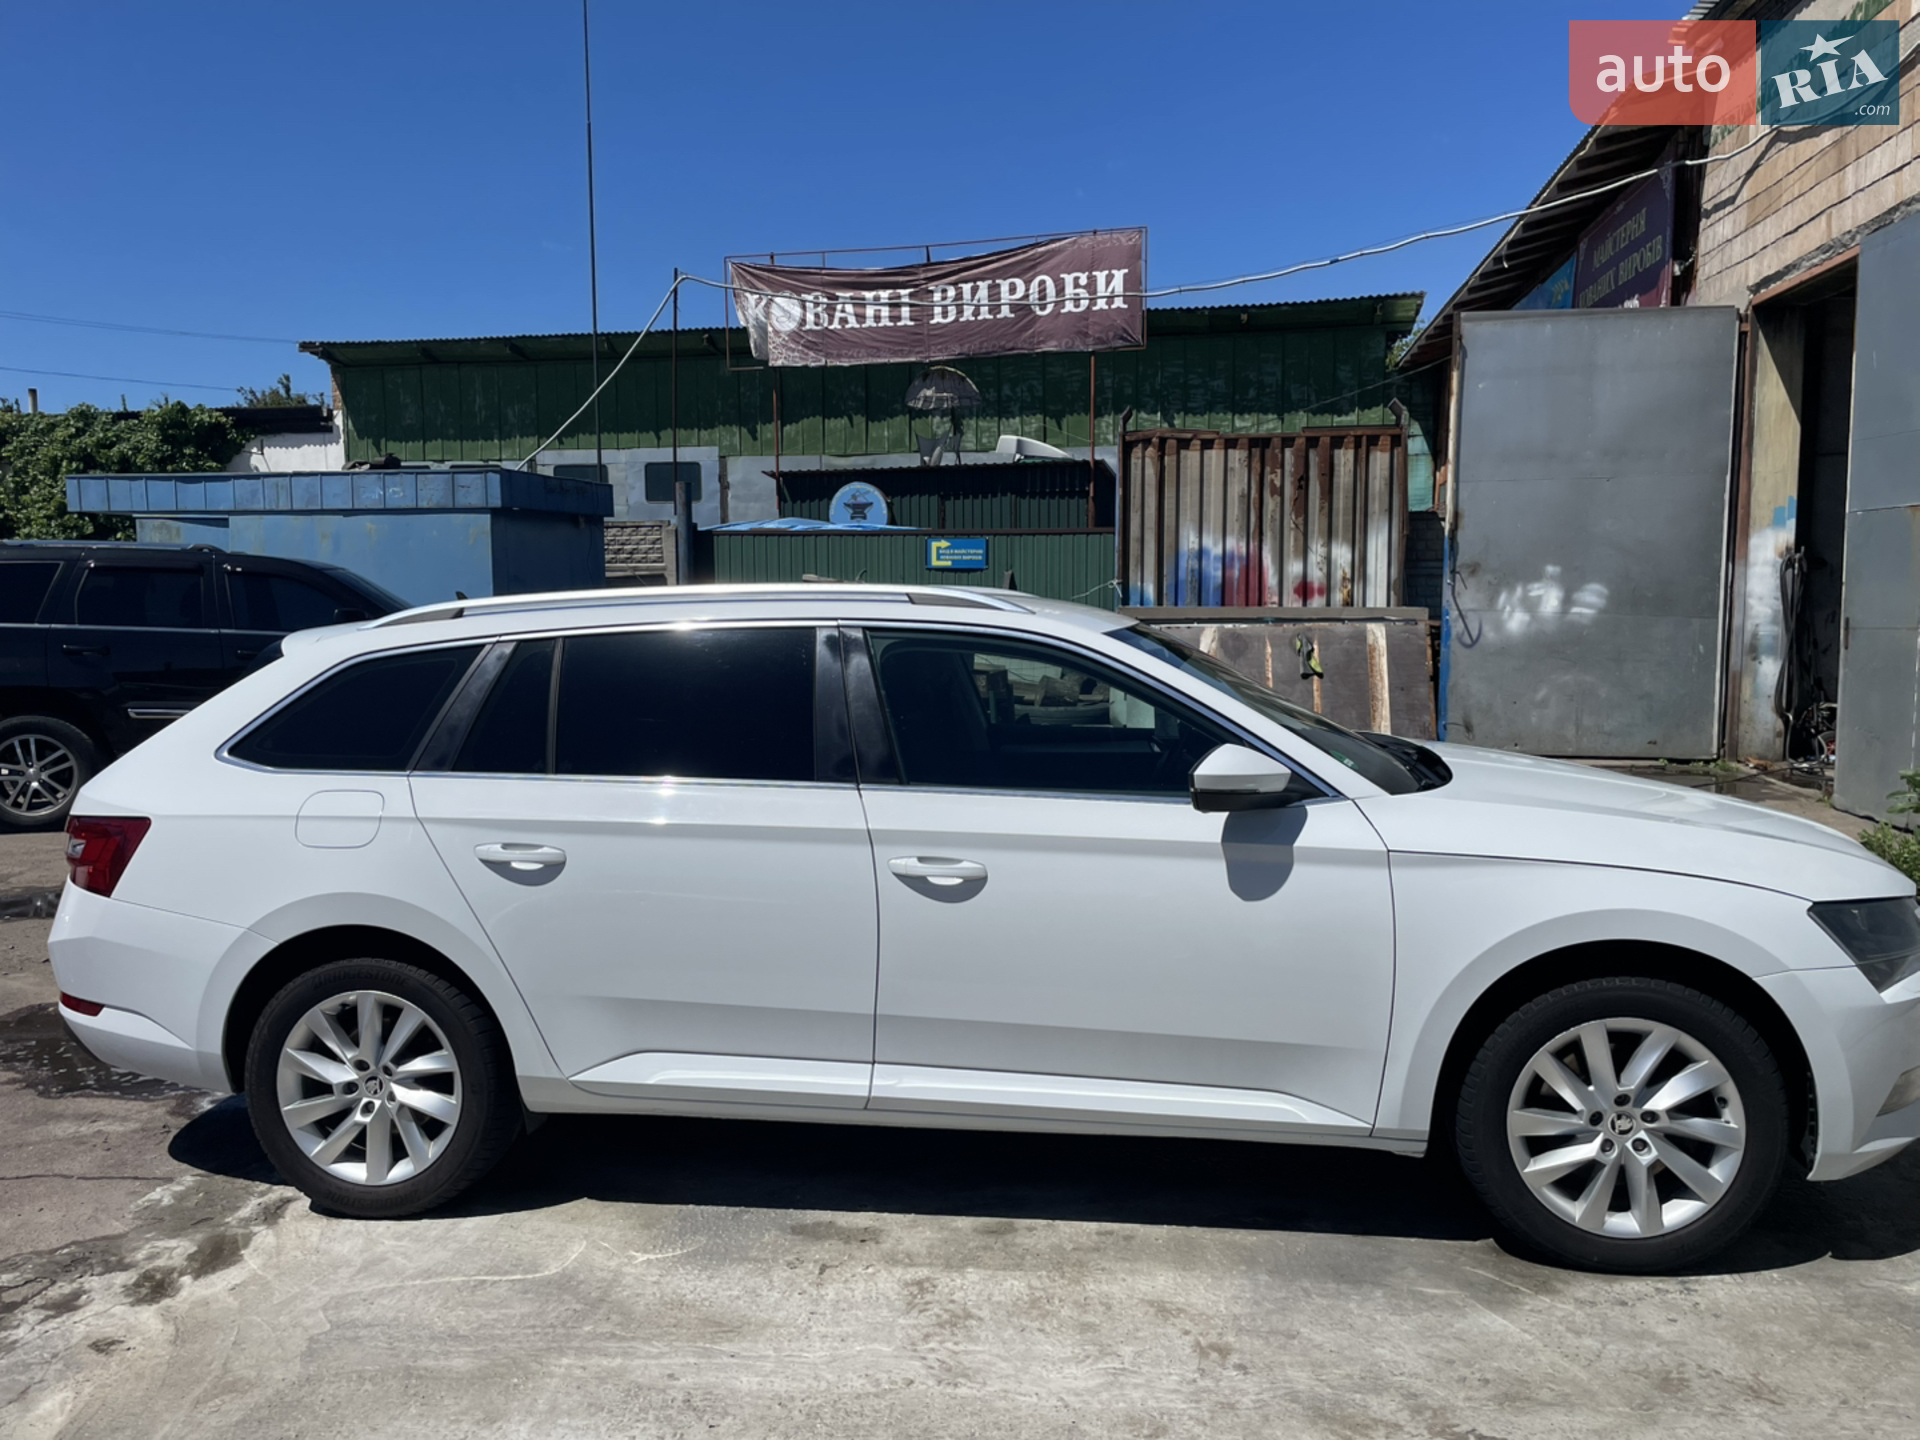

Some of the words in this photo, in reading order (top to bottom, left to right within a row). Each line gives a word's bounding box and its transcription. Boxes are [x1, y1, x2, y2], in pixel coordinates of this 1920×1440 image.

[1617, 234, 1663, 286] ВИРОБІВ
[742, 287, 916, 333] КОВАНІ
[928, 269, 1129, 325] ВИРОБИ
[312, 967, 410, 991] BRIDGESTONE
